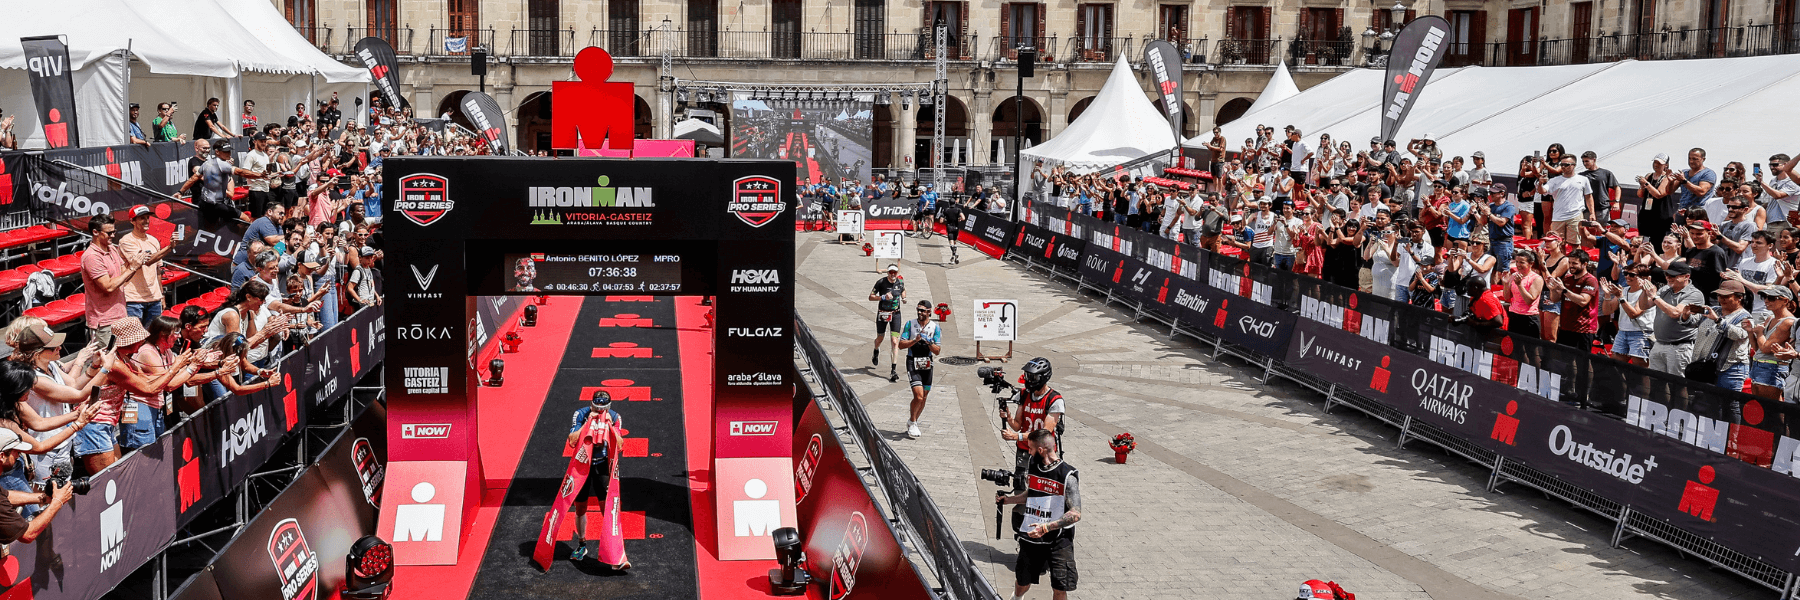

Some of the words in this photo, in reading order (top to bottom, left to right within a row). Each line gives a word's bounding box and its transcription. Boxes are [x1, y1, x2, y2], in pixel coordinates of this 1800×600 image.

[1148, 47, 1179, 115] IRONMAN
[407, 192, 441, 201] IRONMAN
[529, 176, 653, 207] IRONMAN
[741, 194, 774, 203] IRONMAN
[396, 202, 416, 210] PRO
[417, 202, 452, 210] SERIES
[730, 203, 750, 211] PRO
[750, 203, 783, 211] SERIES
[883, 206, 911, 215] TriDot
[566, 213, 652, 221] VITORIA-GASTEIZ
[611, 254, 639, 262] LÓPEZ
[1146, 244, 1197, 281] IRONMAN
[588, 267, 637, 278] 07:36:38
[731, 269, 780, 284] HOKA
[1207, 263, 1273, 307] IRONMAN
[1174, 288, 1210, 314] Santini
[1300, 293, 1390, 346] IRONMAN
[728, 327, 782, 337] FULGAZ
[1316, 345, 1362, 371] VINFAST
[404, 367, 439, 378] VITORIA
[1429, 335, 1562, 402] IRONMAN
[727, 372, 752, 381] araba
[758, 372, 782, 381] álava
[404, 378, 440, 388] GASTEIZ
[1411, 368, 1474, 410] QATAR
[1419, 397, 1467, 425] AIRWAYS
[417, 426, 447, 436] NOW
[744, 423, 773, 433] NOW
[221, 404, 267, 468] HOKA
[1037, 479, 1060, 489] OFFICIAL
[100, 549, 124, 573] NOW
[295, 555, 318, 589] SERIES
